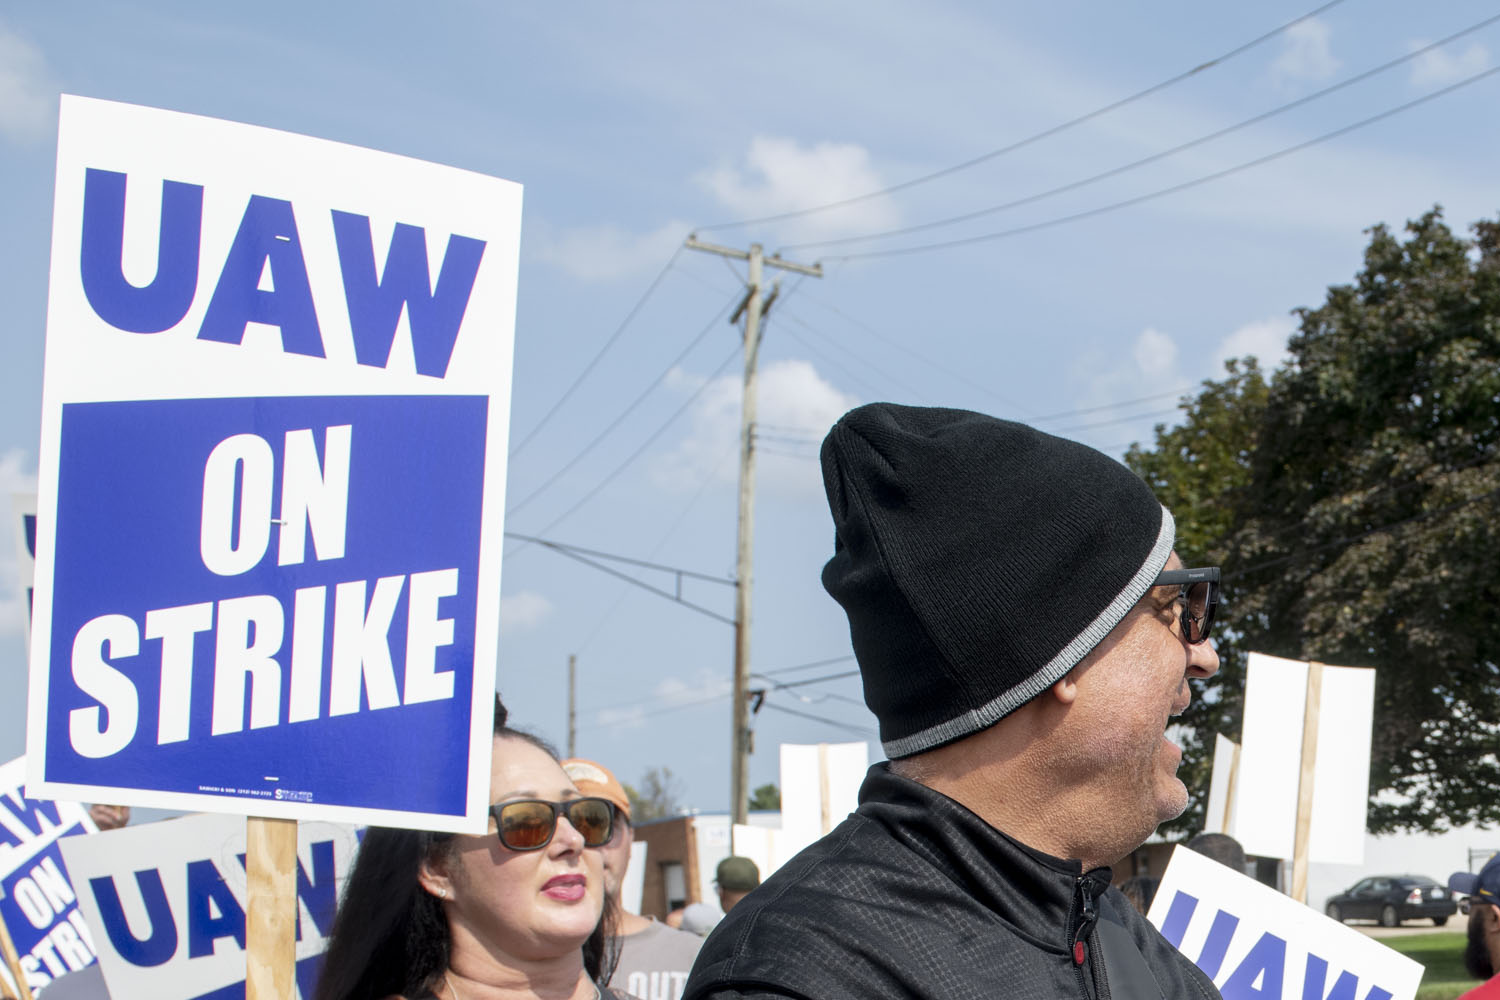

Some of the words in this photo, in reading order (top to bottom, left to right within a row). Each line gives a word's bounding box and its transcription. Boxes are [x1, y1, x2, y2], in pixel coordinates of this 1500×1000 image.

[80, 167, 488, 379] UAW
[200, 425, 353, 577] ON
[69, 568, 460, 760] STRIKE
[14, 856, 76, 930] ON
